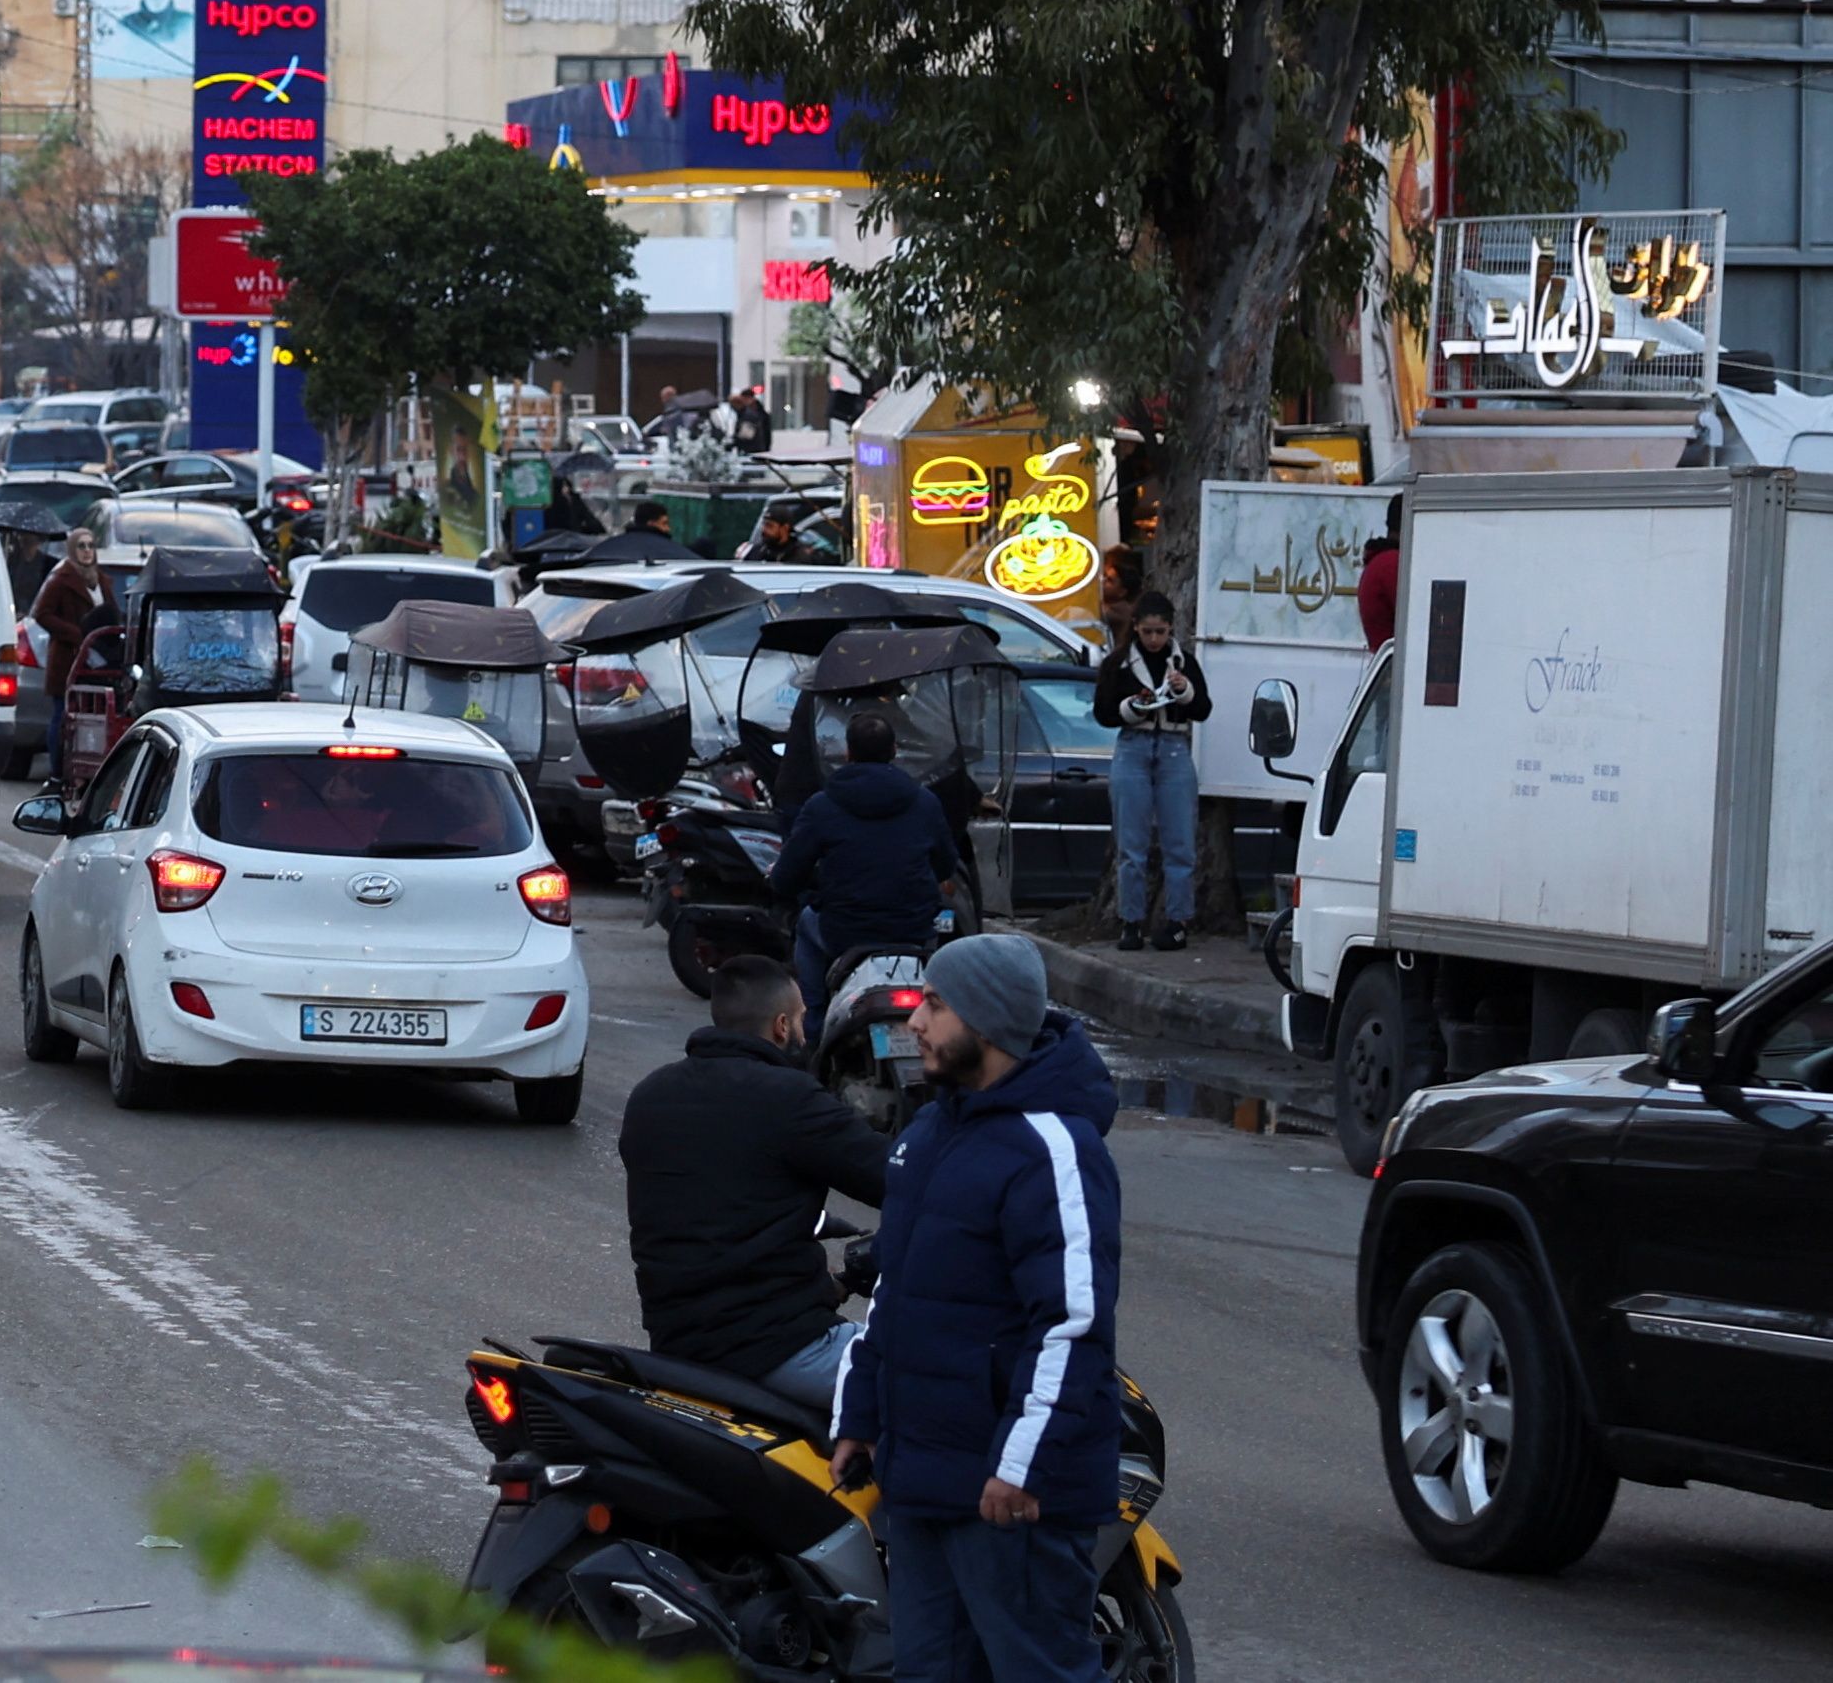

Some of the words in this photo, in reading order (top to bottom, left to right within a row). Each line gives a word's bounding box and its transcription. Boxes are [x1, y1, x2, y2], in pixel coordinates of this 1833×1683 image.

[207, 0, 318, 37] Hypco
[203, 117, 317, 141] HACHEM
[234, 270, 298, 292] whi
[998, 483, 1080, 532] pasta
[320, 1010, 334, 1033] S
[349, 1010, 430, 1037] 224355
